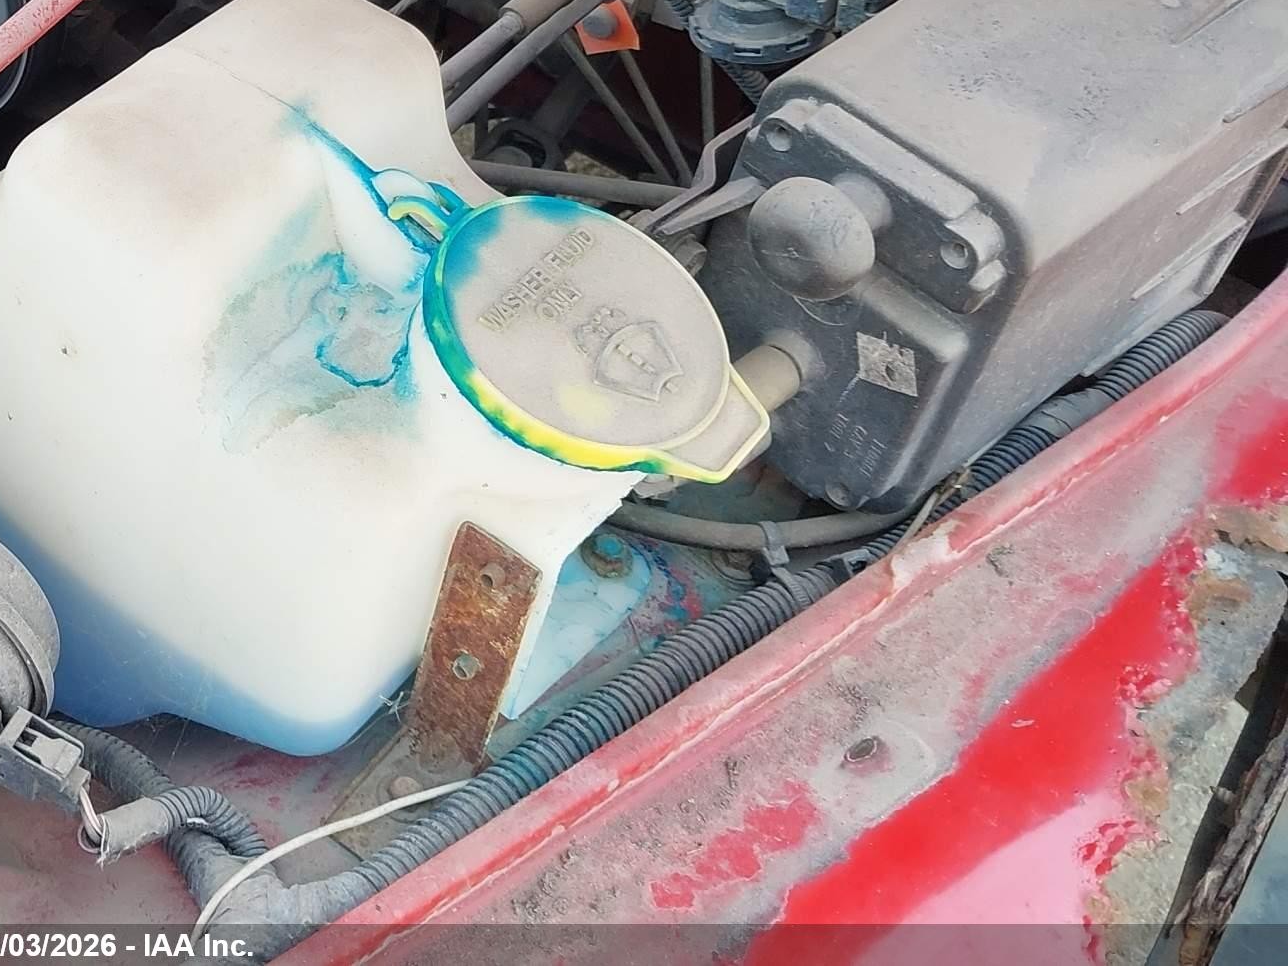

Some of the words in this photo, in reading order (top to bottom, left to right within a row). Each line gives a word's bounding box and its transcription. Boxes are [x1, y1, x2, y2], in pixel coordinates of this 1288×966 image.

[478, 265, 551, 333] WASHER
[543, 228, 594, 279] FLUID
[536, 282, 583, 322] ONLY
